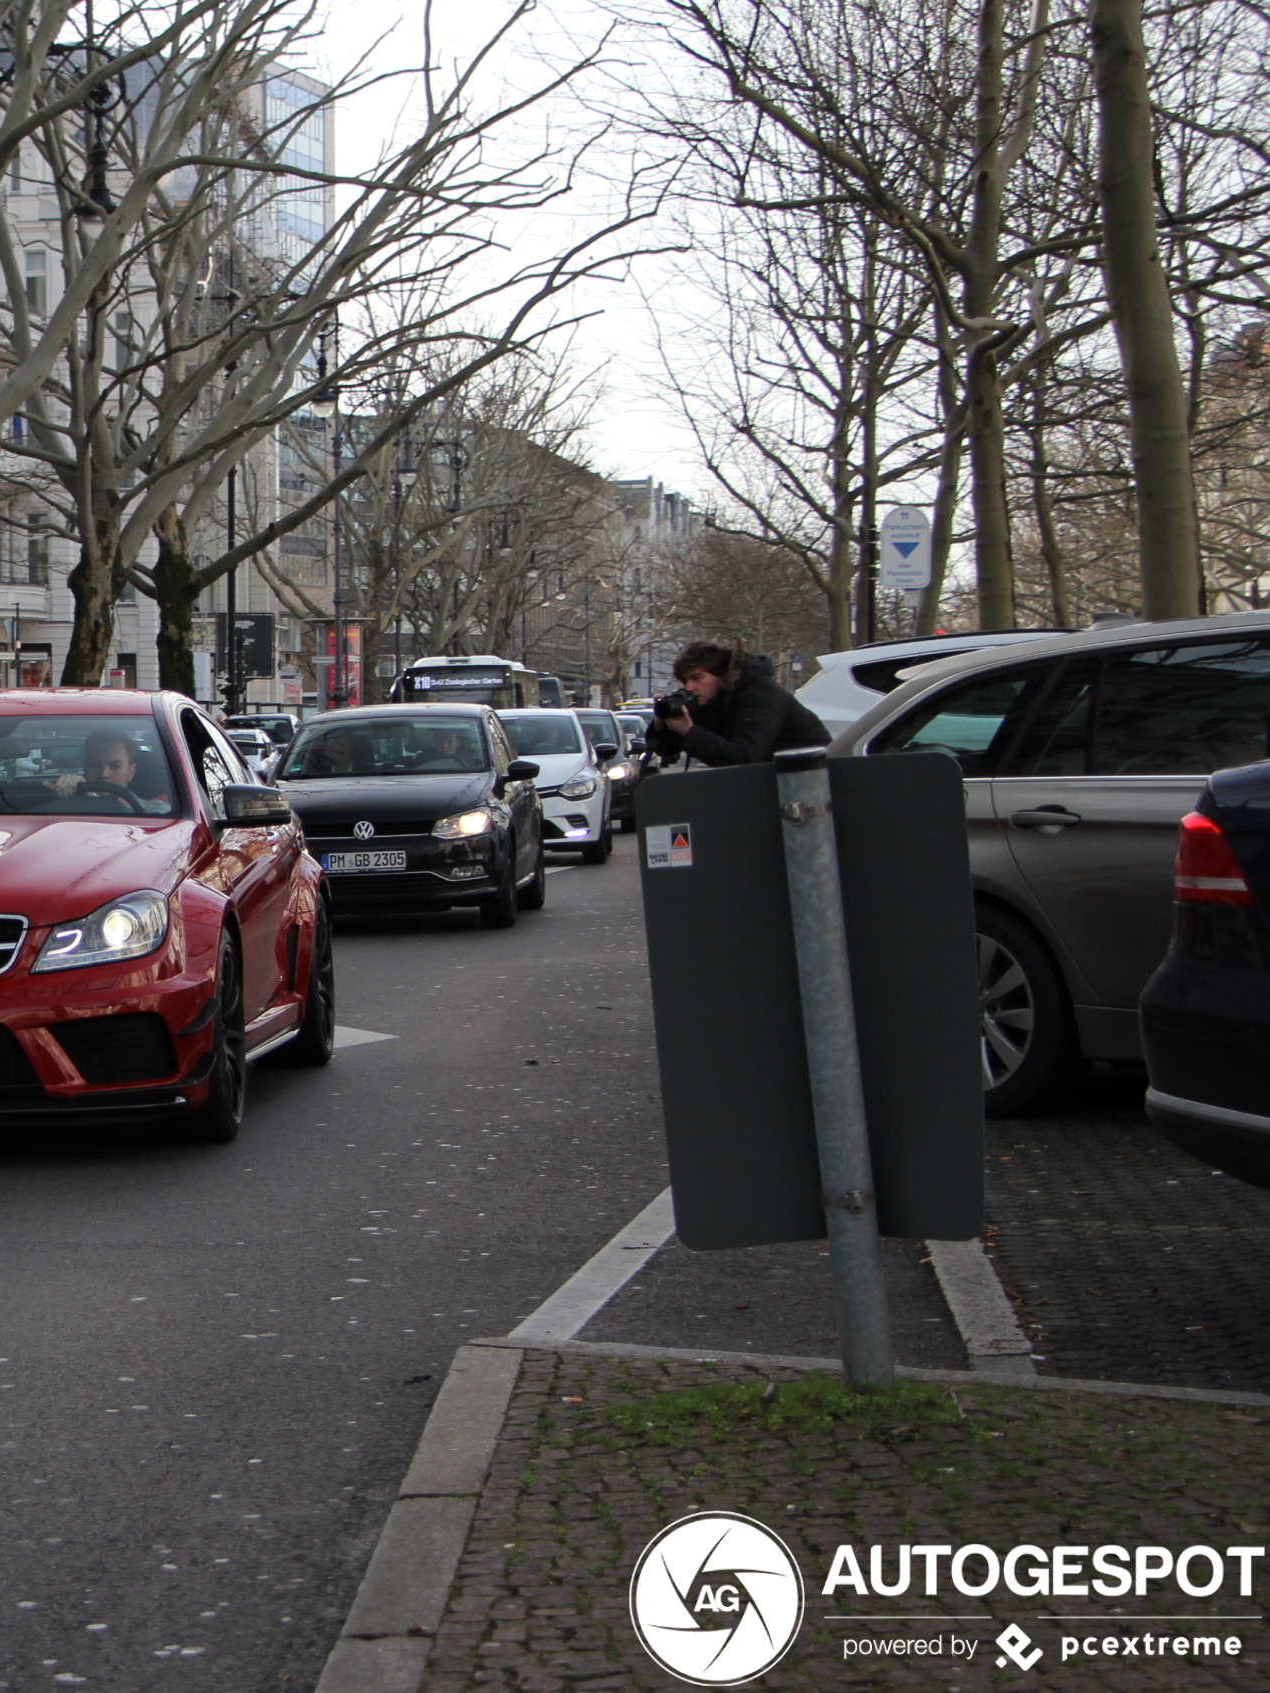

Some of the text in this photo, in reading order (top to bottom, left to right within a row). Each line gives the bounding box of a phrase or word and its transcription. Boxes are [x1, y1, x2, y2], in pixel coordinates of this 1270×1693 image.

[414, 676, 431, 689] X10
[445, 678, 481, 686] Zoologischer
[482, 677, 503, 685] Garten
[330, 852, 404, 868] PM GB 2305
